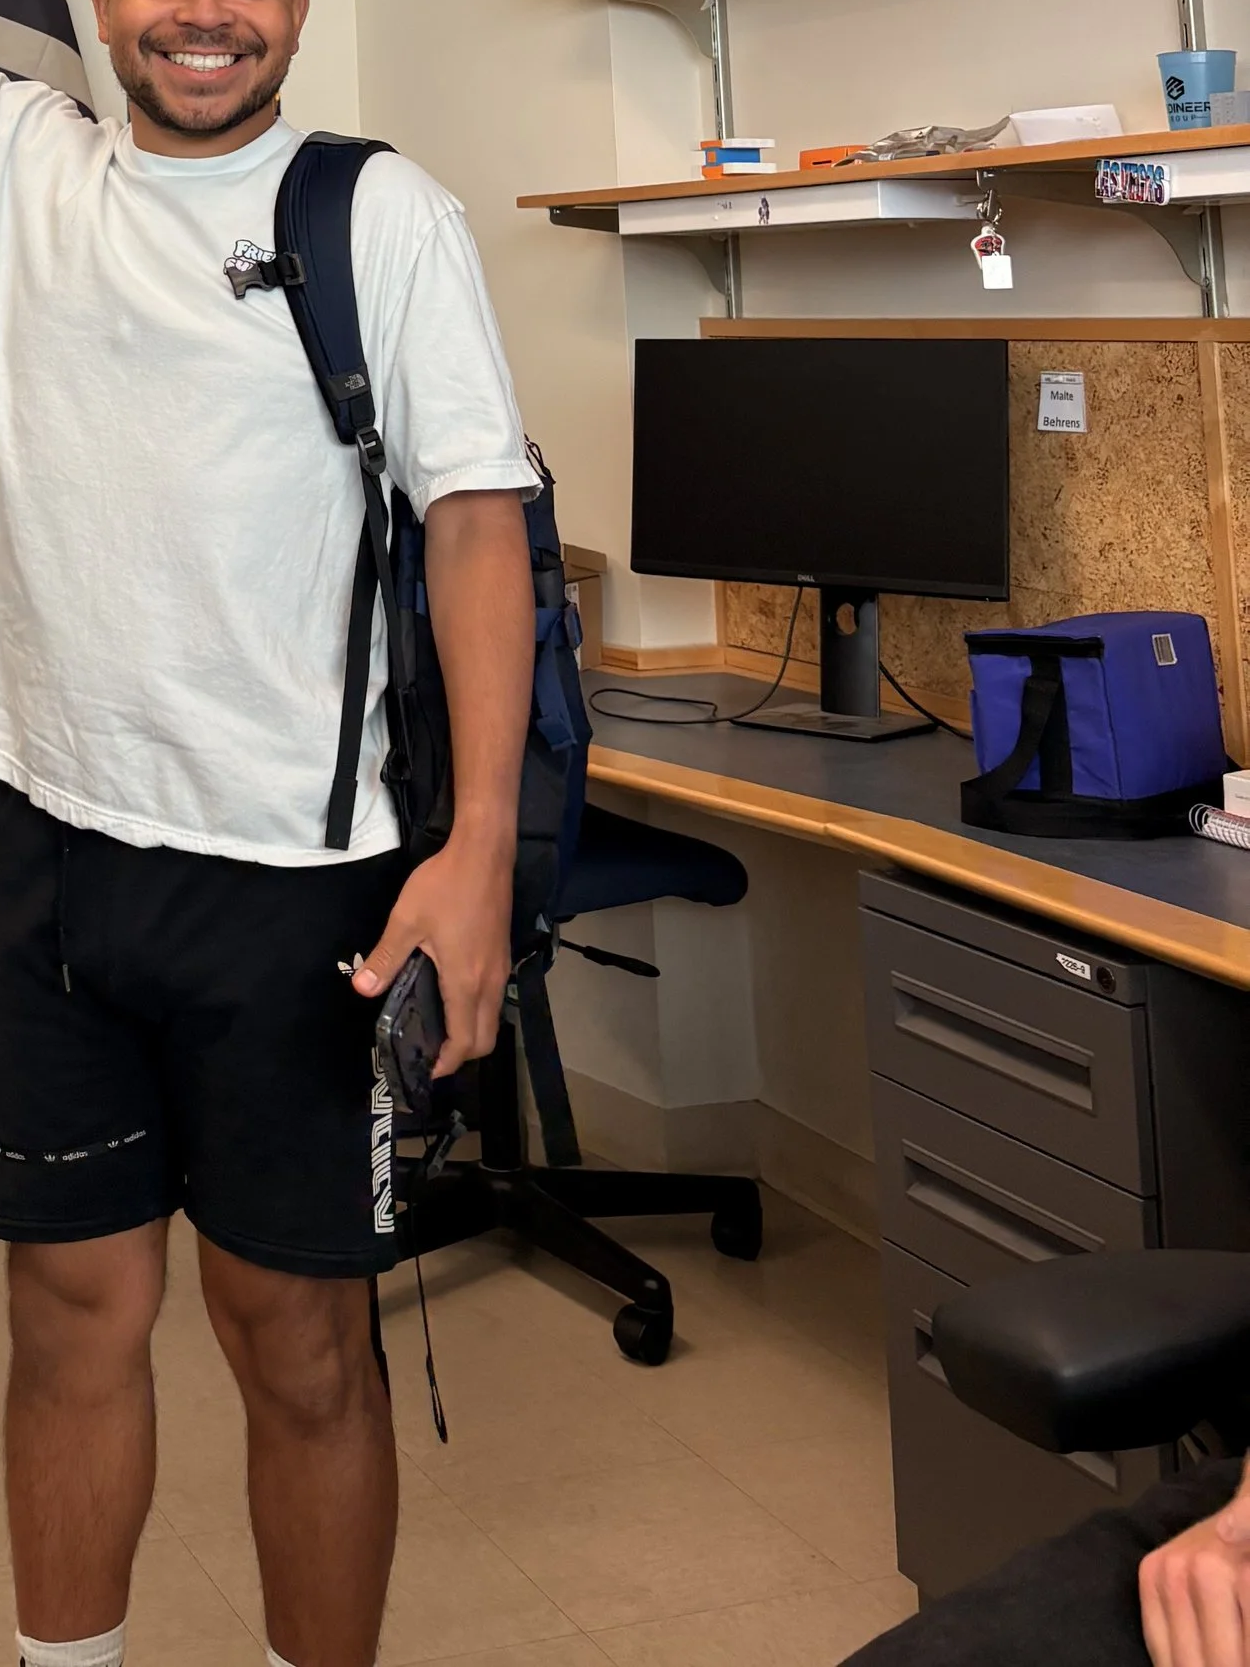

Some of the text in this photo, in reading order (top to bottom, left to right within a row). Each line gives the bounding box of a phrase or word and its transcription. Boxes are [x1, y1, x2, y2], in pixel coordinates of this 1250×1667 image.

[1096, 159, 1165, 204] LAS VEGAS
[233, 239, 277, 263] FRIE
[1050, 390, 1074, 401] Malte
[1043, 416, 1081, 429] Behrens
[797, 574, 815, 583] DELL
[123, 1130, 147, 1144] adidas
[62, 1150, 88, 1162] adidas
